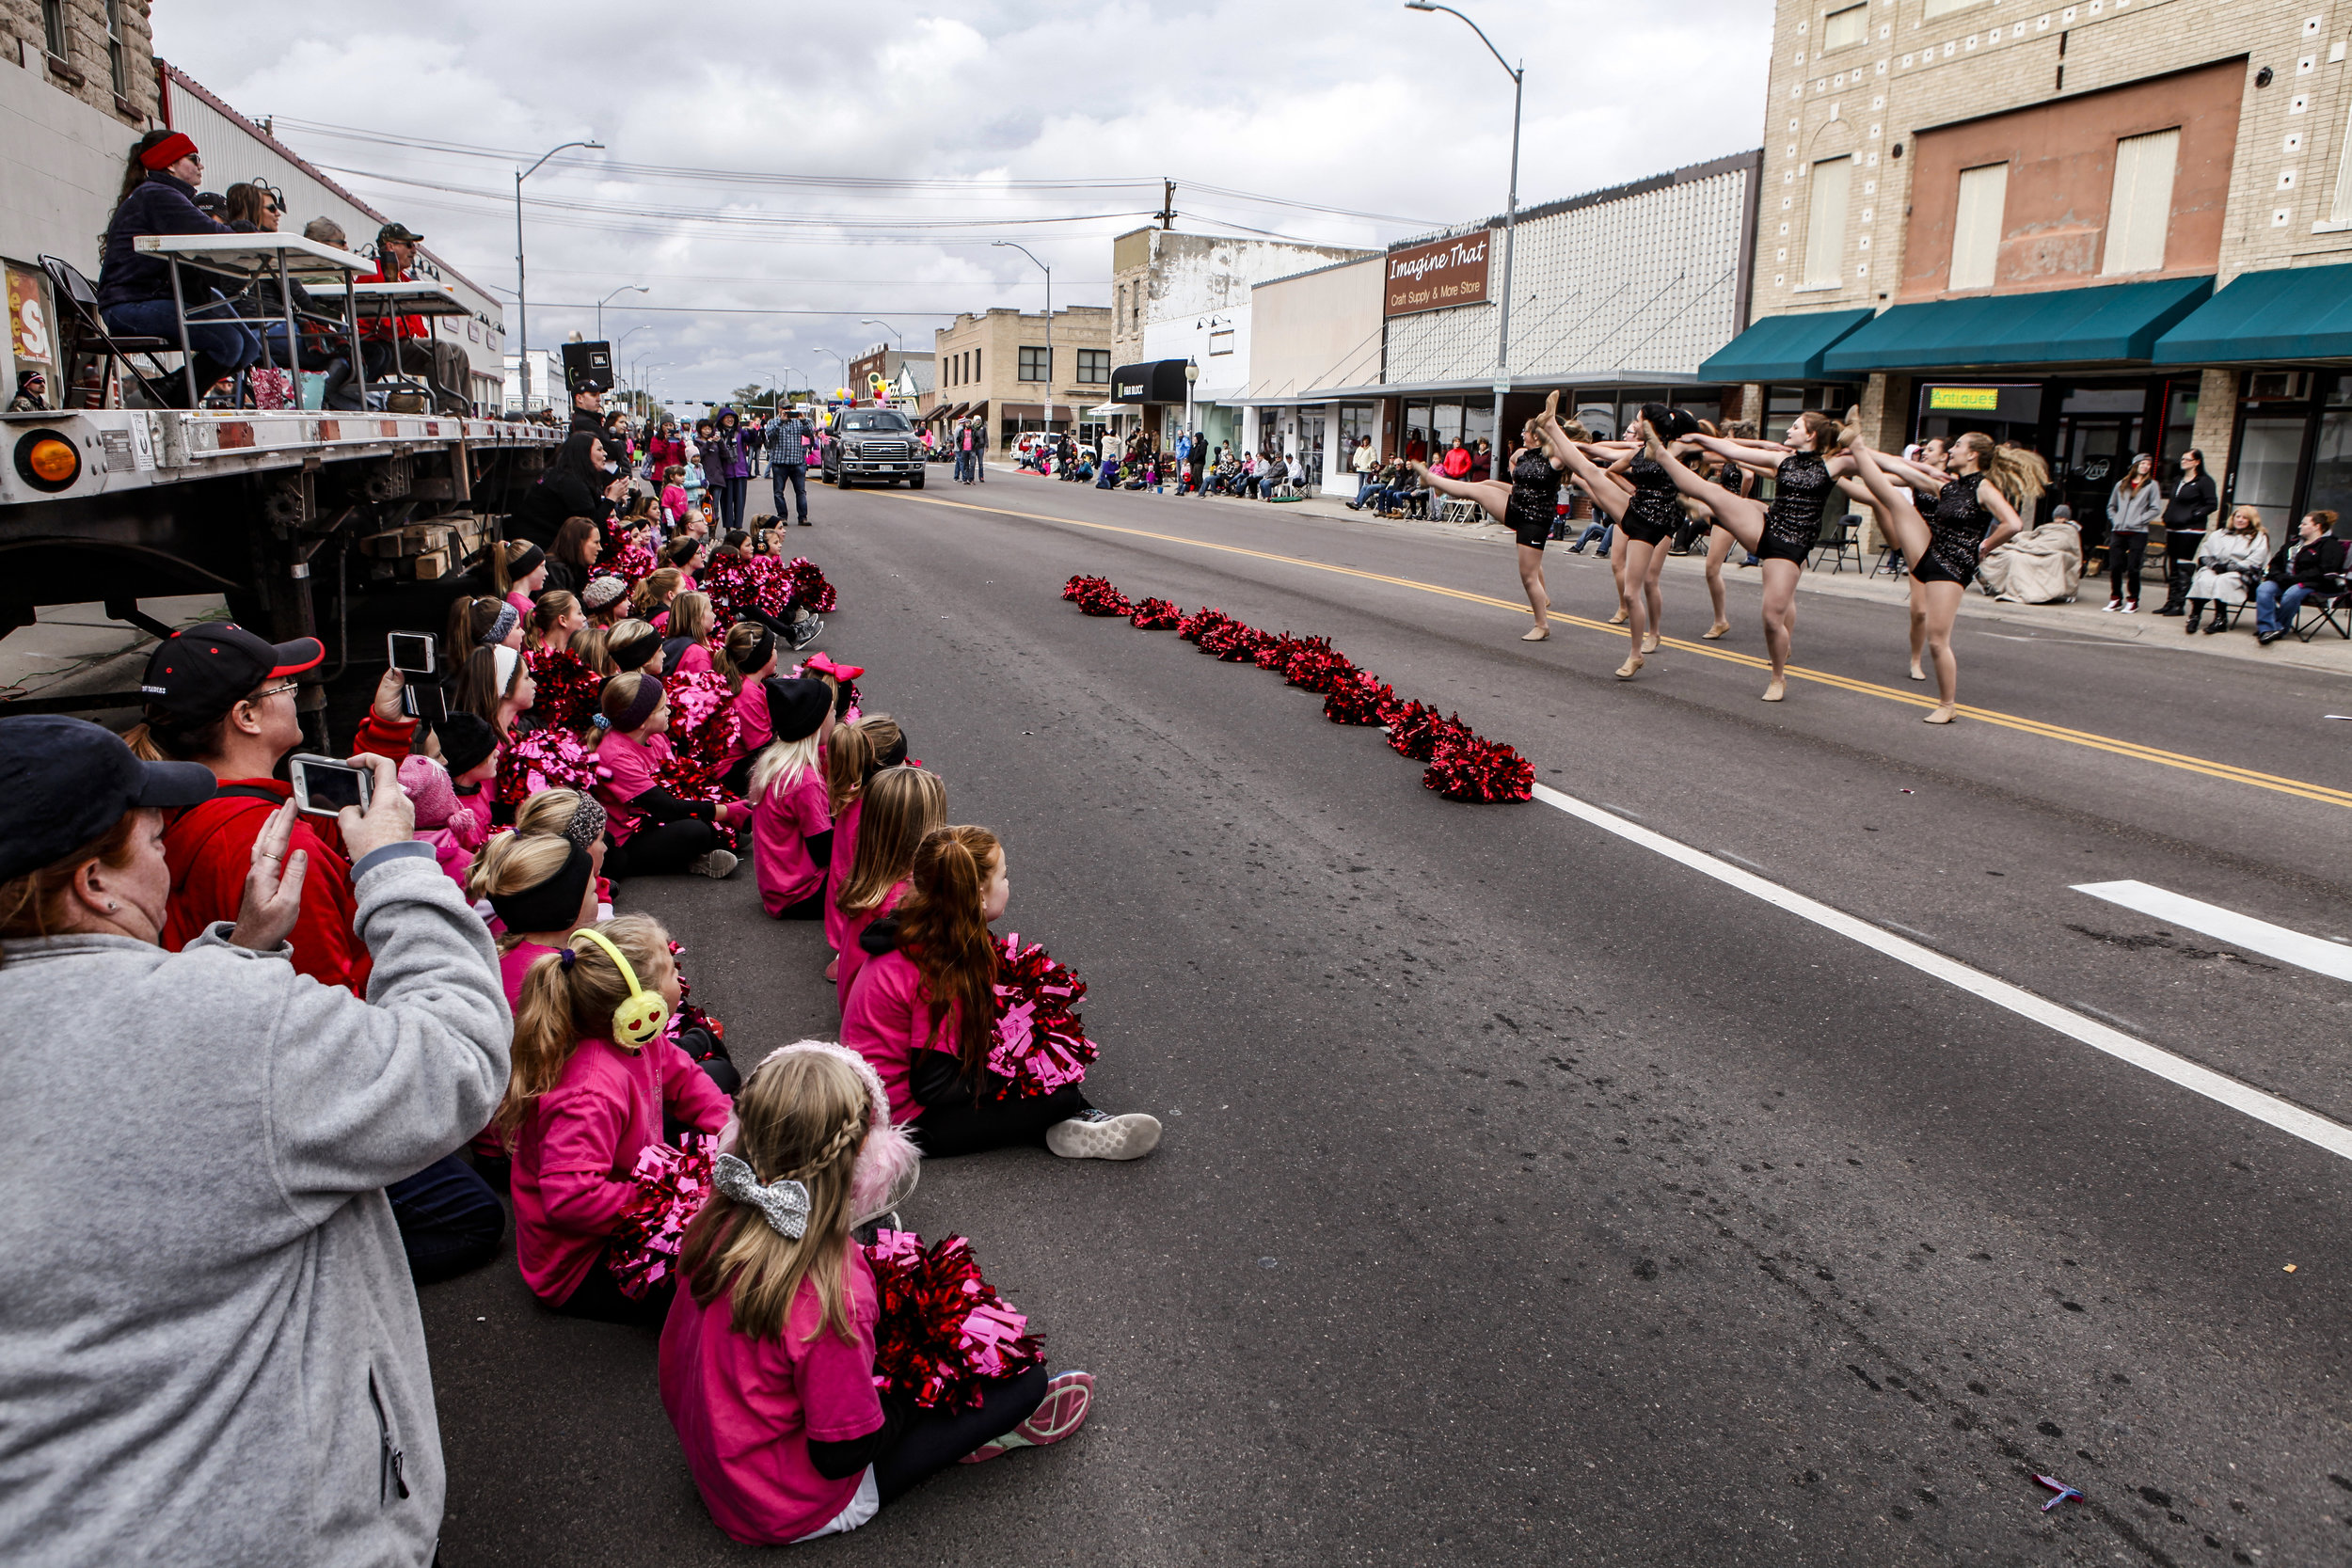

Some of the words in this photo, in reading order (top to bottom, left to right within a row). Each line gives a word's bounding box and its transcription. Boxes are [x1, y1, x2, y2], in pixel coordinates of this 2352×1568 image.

[1390, 253, 1448, 280] Imagine
[1450, 240, 1486, 268] That
[1391, 293, 1406, 307] Craft
[1408, 289, 1430, 305] Supply
[1432, 287, 1438, 299] &
[1440, 285, 1458, 297] More
[1460, 281, 1481, 294] Store
[1132, 384, 1144, 395] BLOCK
[1933, 390, 1996, 406] Antiques
